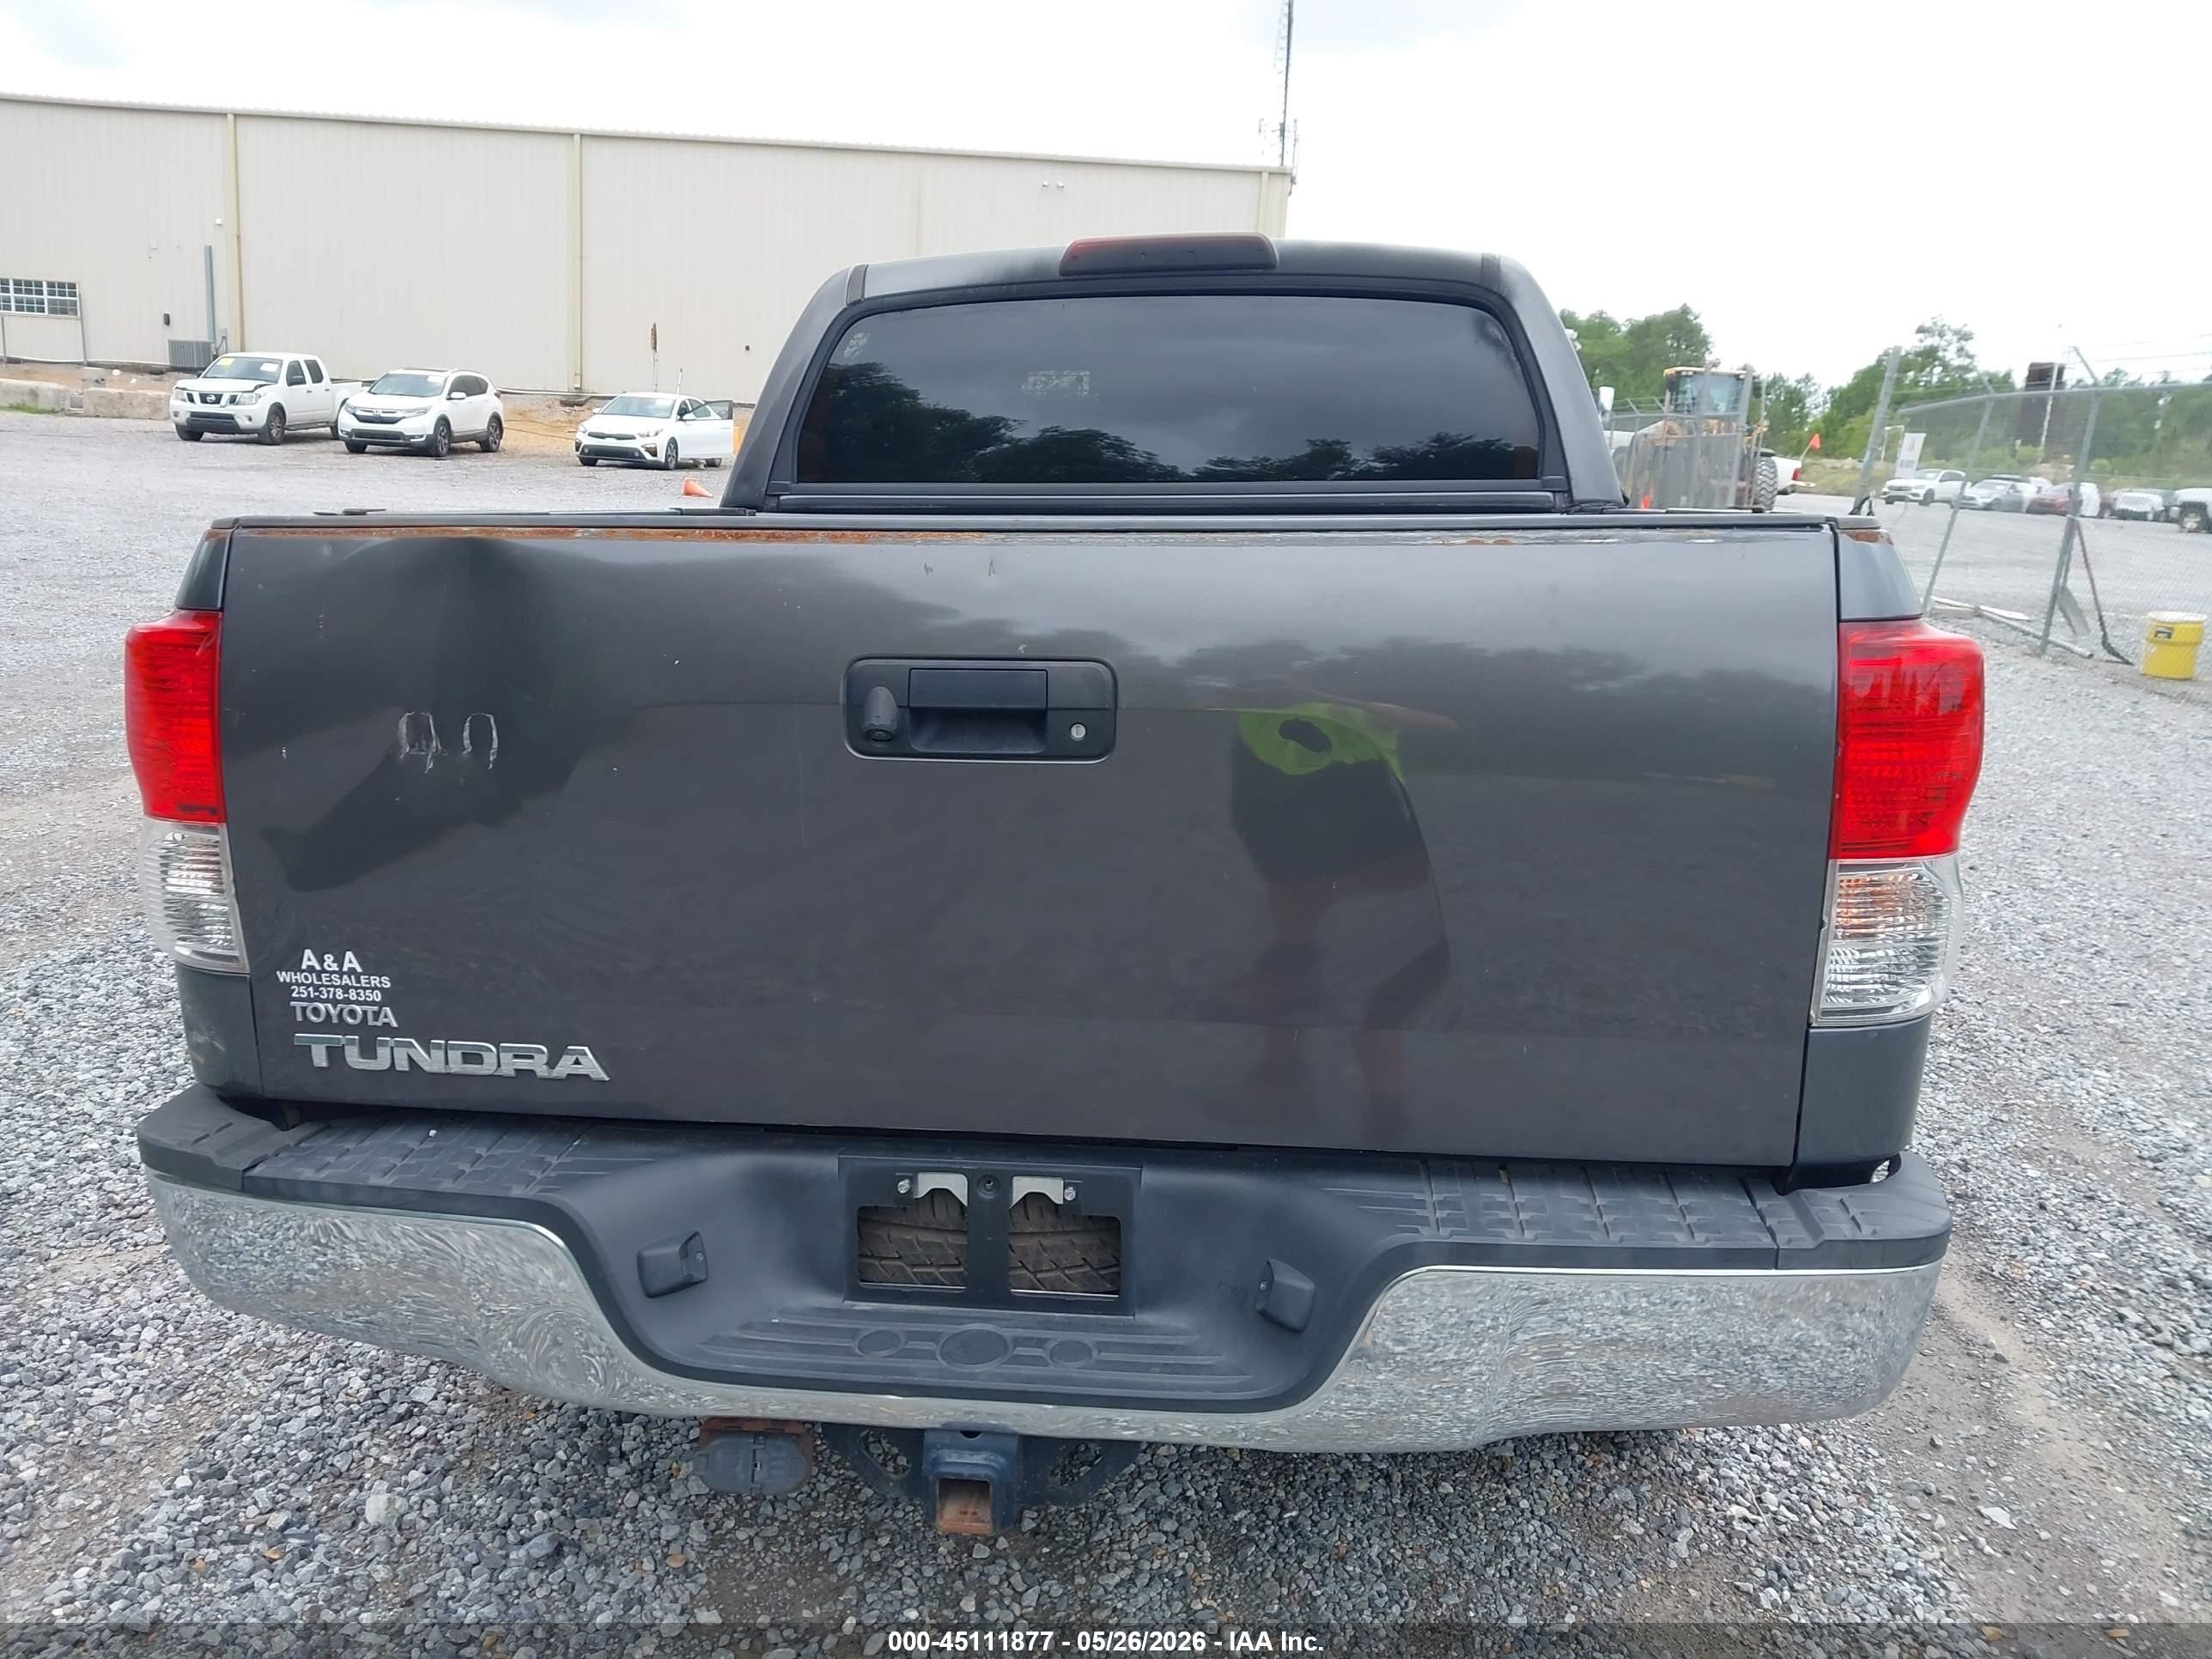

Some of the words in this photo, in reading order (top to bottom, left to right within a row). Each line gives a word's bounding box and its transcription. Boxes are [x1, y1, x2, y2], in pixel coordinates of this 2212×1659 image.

[301, 949, 322, 971] A
[323, 953, 340, 972] &
[342, 951, 363, 973] A
[276, 970, 392, 989] WHOLESALERS
[290, 985, 382, 1002] 251-378-8350
[289, 1001, 398, 1028] TOYOTA
[294, 1033, 611, 1082] TUNDRA
